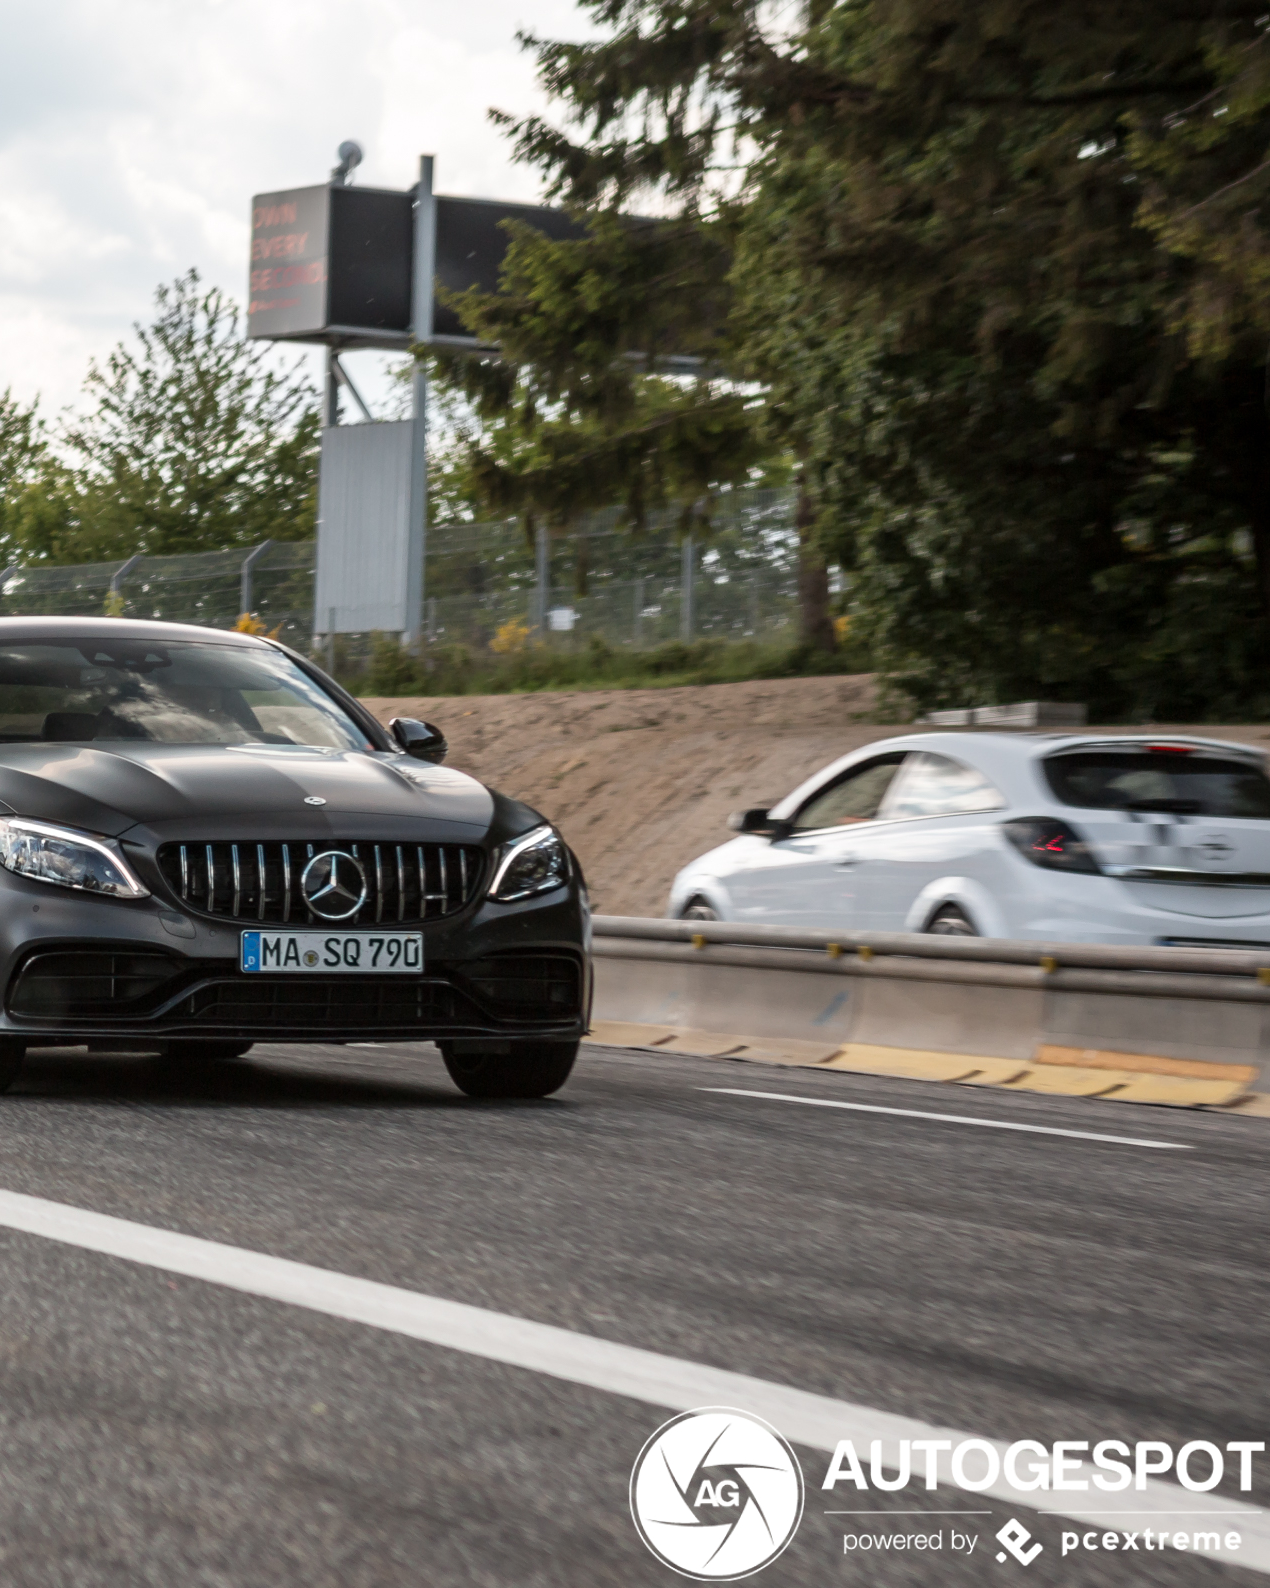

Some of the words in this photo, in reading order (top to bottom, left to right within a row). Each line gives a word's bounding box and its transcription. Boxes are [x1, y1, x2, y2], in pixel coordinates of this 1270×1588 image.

[252, 231, 309, 261] EVERY
[262, 937, 301, 967] MA
[323, 937, 361, 967] SQ
[368, 938, 420, 967] 790
